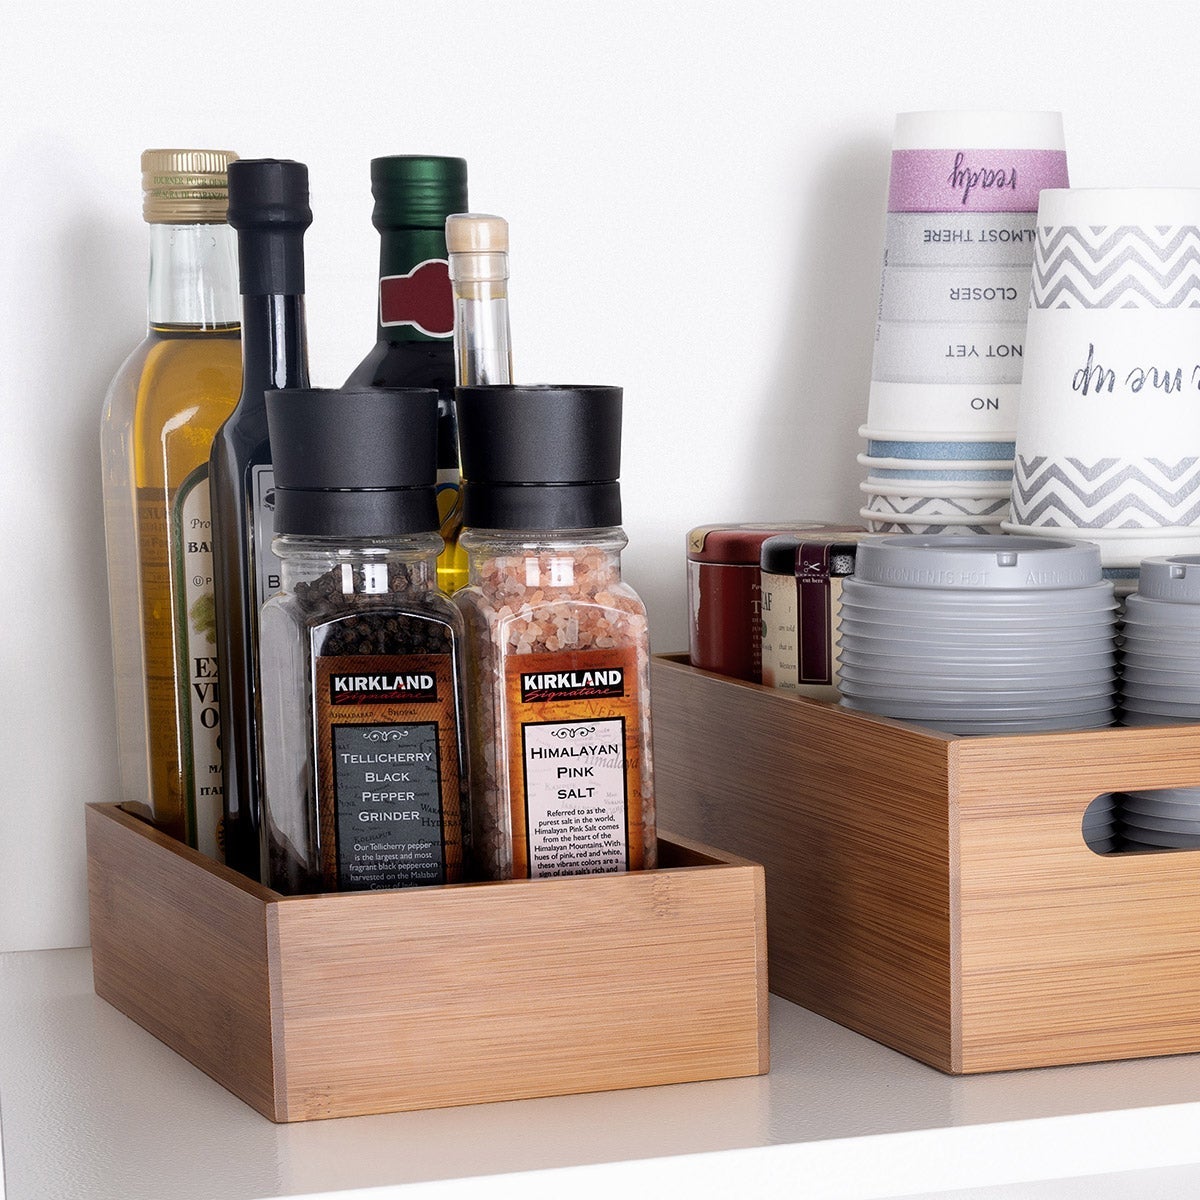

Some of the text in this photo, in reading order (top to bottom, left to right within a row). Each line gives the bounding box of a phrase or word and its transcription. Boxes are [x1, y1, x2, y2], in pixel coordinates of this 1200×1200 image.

[949, 152, 1016, 204] ready
[924, 229, 973, 242] THERE
[950, 287, 1017, 301] CLOSER
[945, 344, 1023, 358] NOT YET
[1072, 343, 1116, 396] up
[1125, 366, 1183, 394] me
[970, 398, 999, 411] NO
[334, 675, 434, 692] KIRKLAND
[524, 670, 622, 691] KIRKLAND
[335, 691, 435, 705] Signature
[523, 687, 623, 703] Signature
[340, 752, 432, 764] TELLICHERRY
[531, 744, 619, 760] HIMALAYAN
[365, 772, 410, 783] BLACK
[557, 766, 594, 779] PINK
[362, 792, 415, 802] PEPPER
[557, 787, 595, 800] SALT
[358, 811, 420, 822] GRINDER
[547, 808, 576, 817] Referred
[538, 818, 560, 827] purest
[561, 817, 573, 825] salt
[534, 827, 568, 835] Himalayan
[543, 836, 559, 844] from
[353, 842, 432, 852] Our Tellicherry pepper
[534, 844, 567, 853] Himalayan
[362, 853, 374, 861] the
[375, 853, 399, 862] largest
[400, 852, 413, 860] and
[414, 851, 433, 859] most
[349, 862, 438, 874] fragrant black peppercorn
[557, 860, 580, 868] vibrant
[350, 873, 385, 882] harvested
[397, 872, 409, 880] the
[411, 871, 438, 879] Malabar
